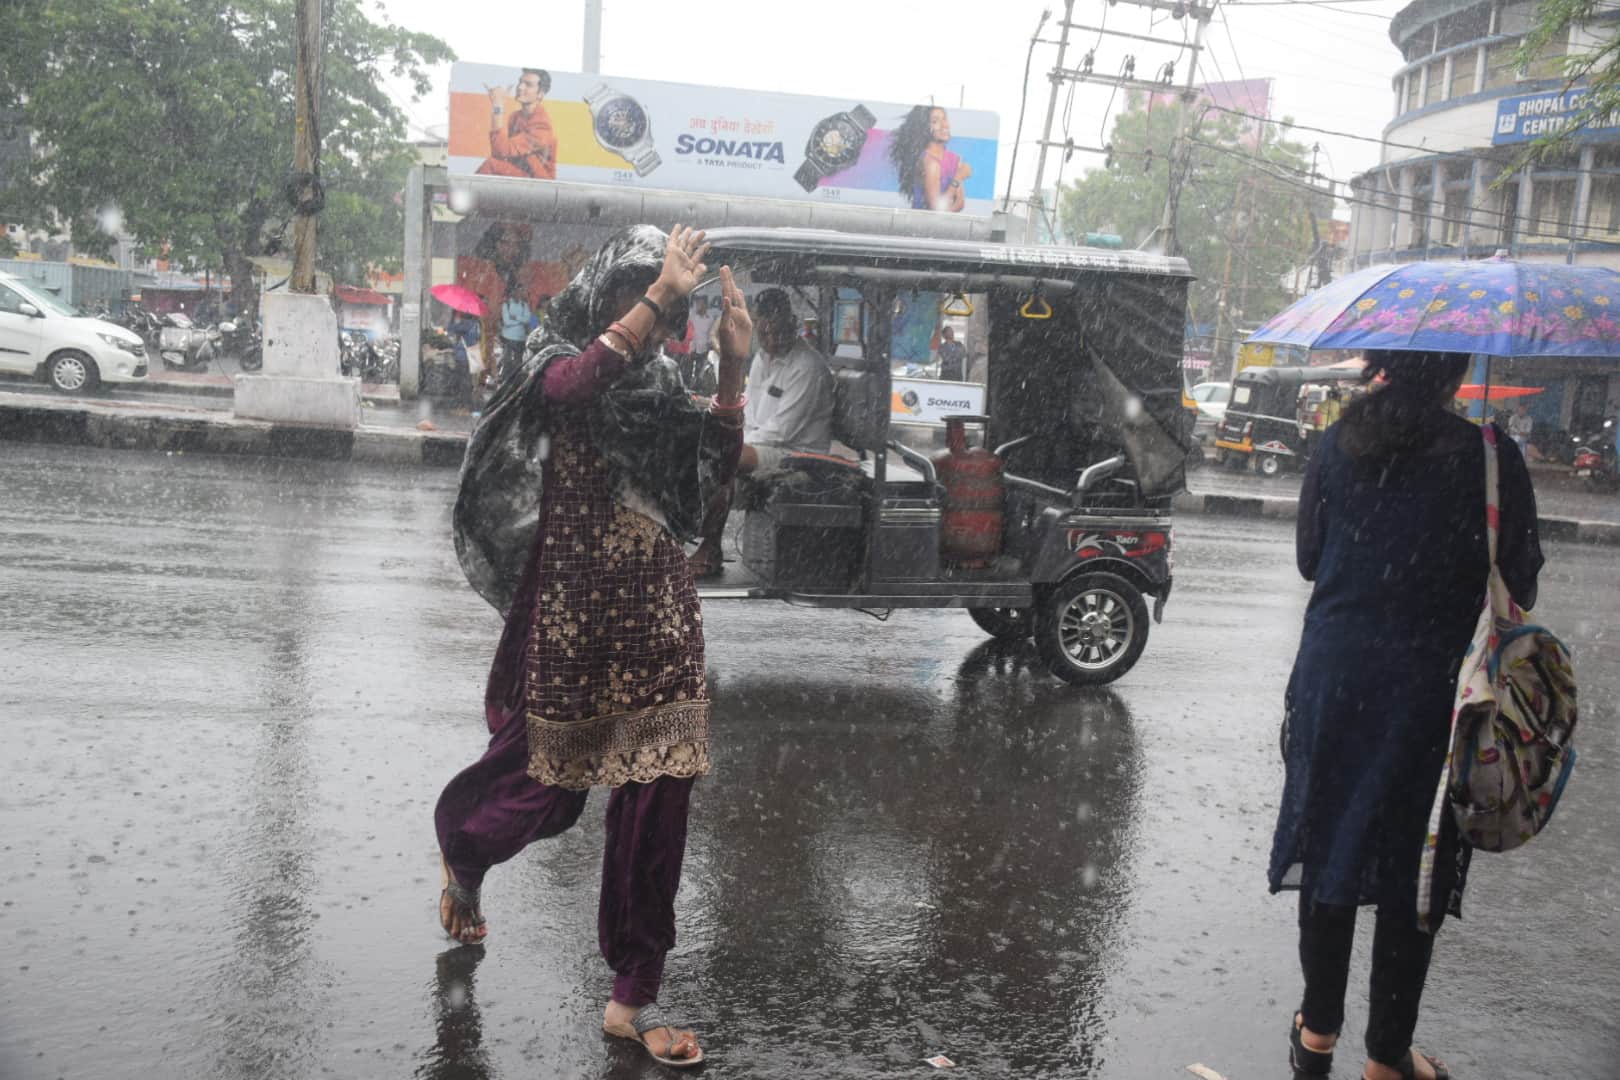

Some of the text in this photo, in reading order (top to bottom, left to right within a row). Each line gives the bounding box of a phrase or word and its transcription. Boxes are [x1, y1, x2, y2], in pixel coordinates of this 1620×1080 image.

[1519, 97, 1567, 116] BHOPAL
[674, 133, 785, 164] SONATA
[703, 159, 725, 168] TATA
[726, 161, 763, 170] PRODUCT
[927, 397, 971, 409] SONATA
